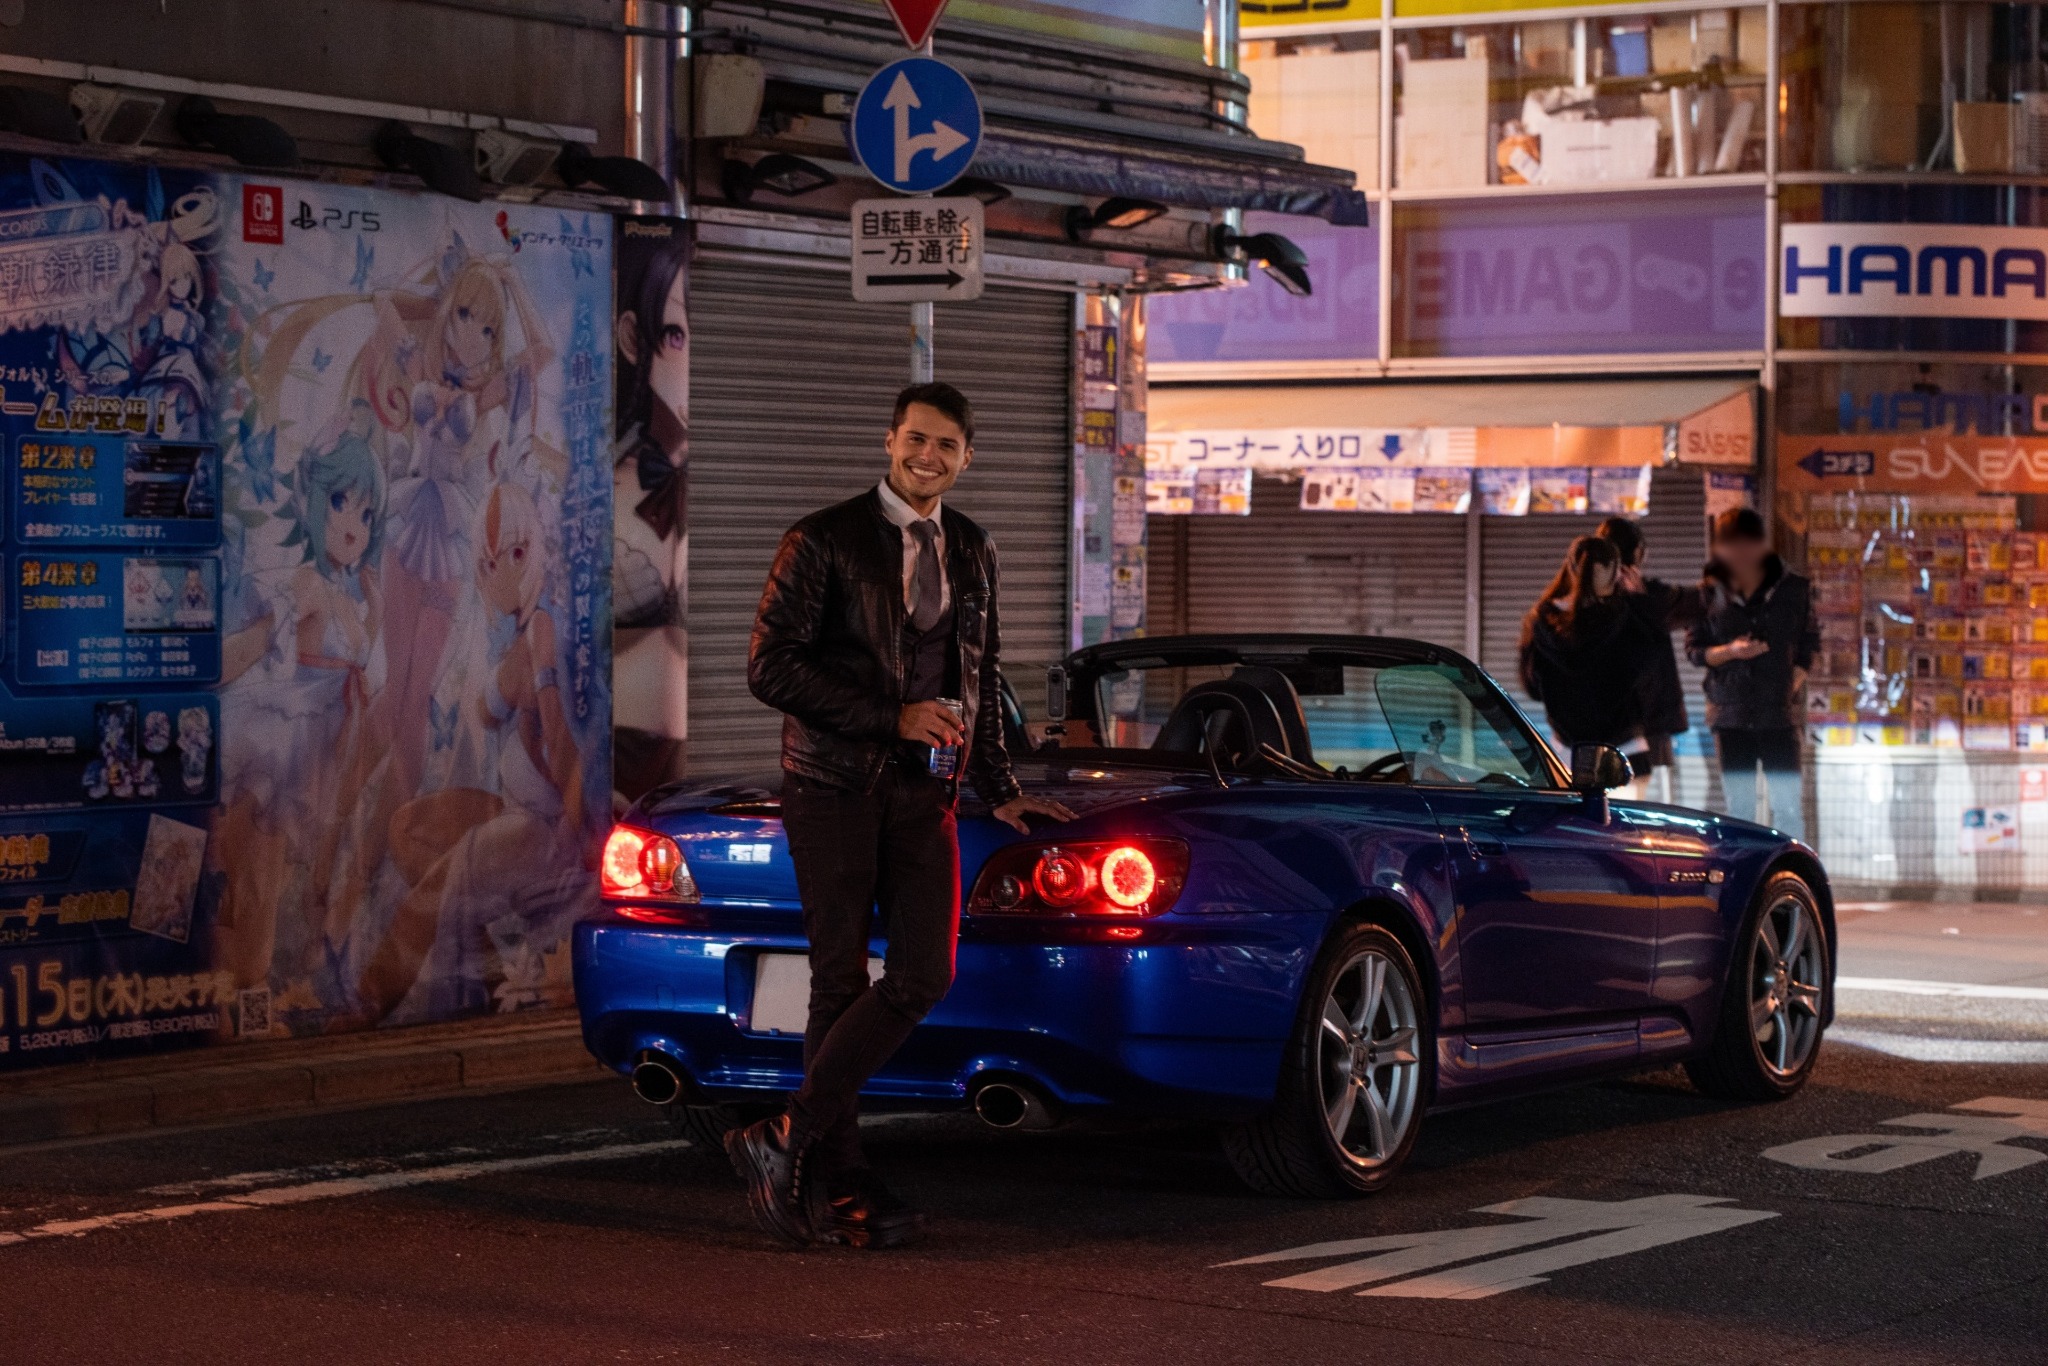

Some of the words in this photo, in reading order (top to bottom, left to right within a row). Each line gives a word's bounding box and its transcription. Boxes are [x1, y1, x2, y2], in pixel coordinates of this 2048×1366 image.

[323, 208, 380, 231] PS5
[862, 209, 970, 236] 自転車を除く
[862, 239, 971, 265] 一方通行
[1784, 245, 2046, 299] HAMA
[0, 387, 167, 434] ームが登場!
[1188, 437, 1280, 460] コーナー
[1290, 434, 1360, 460] 入り口
